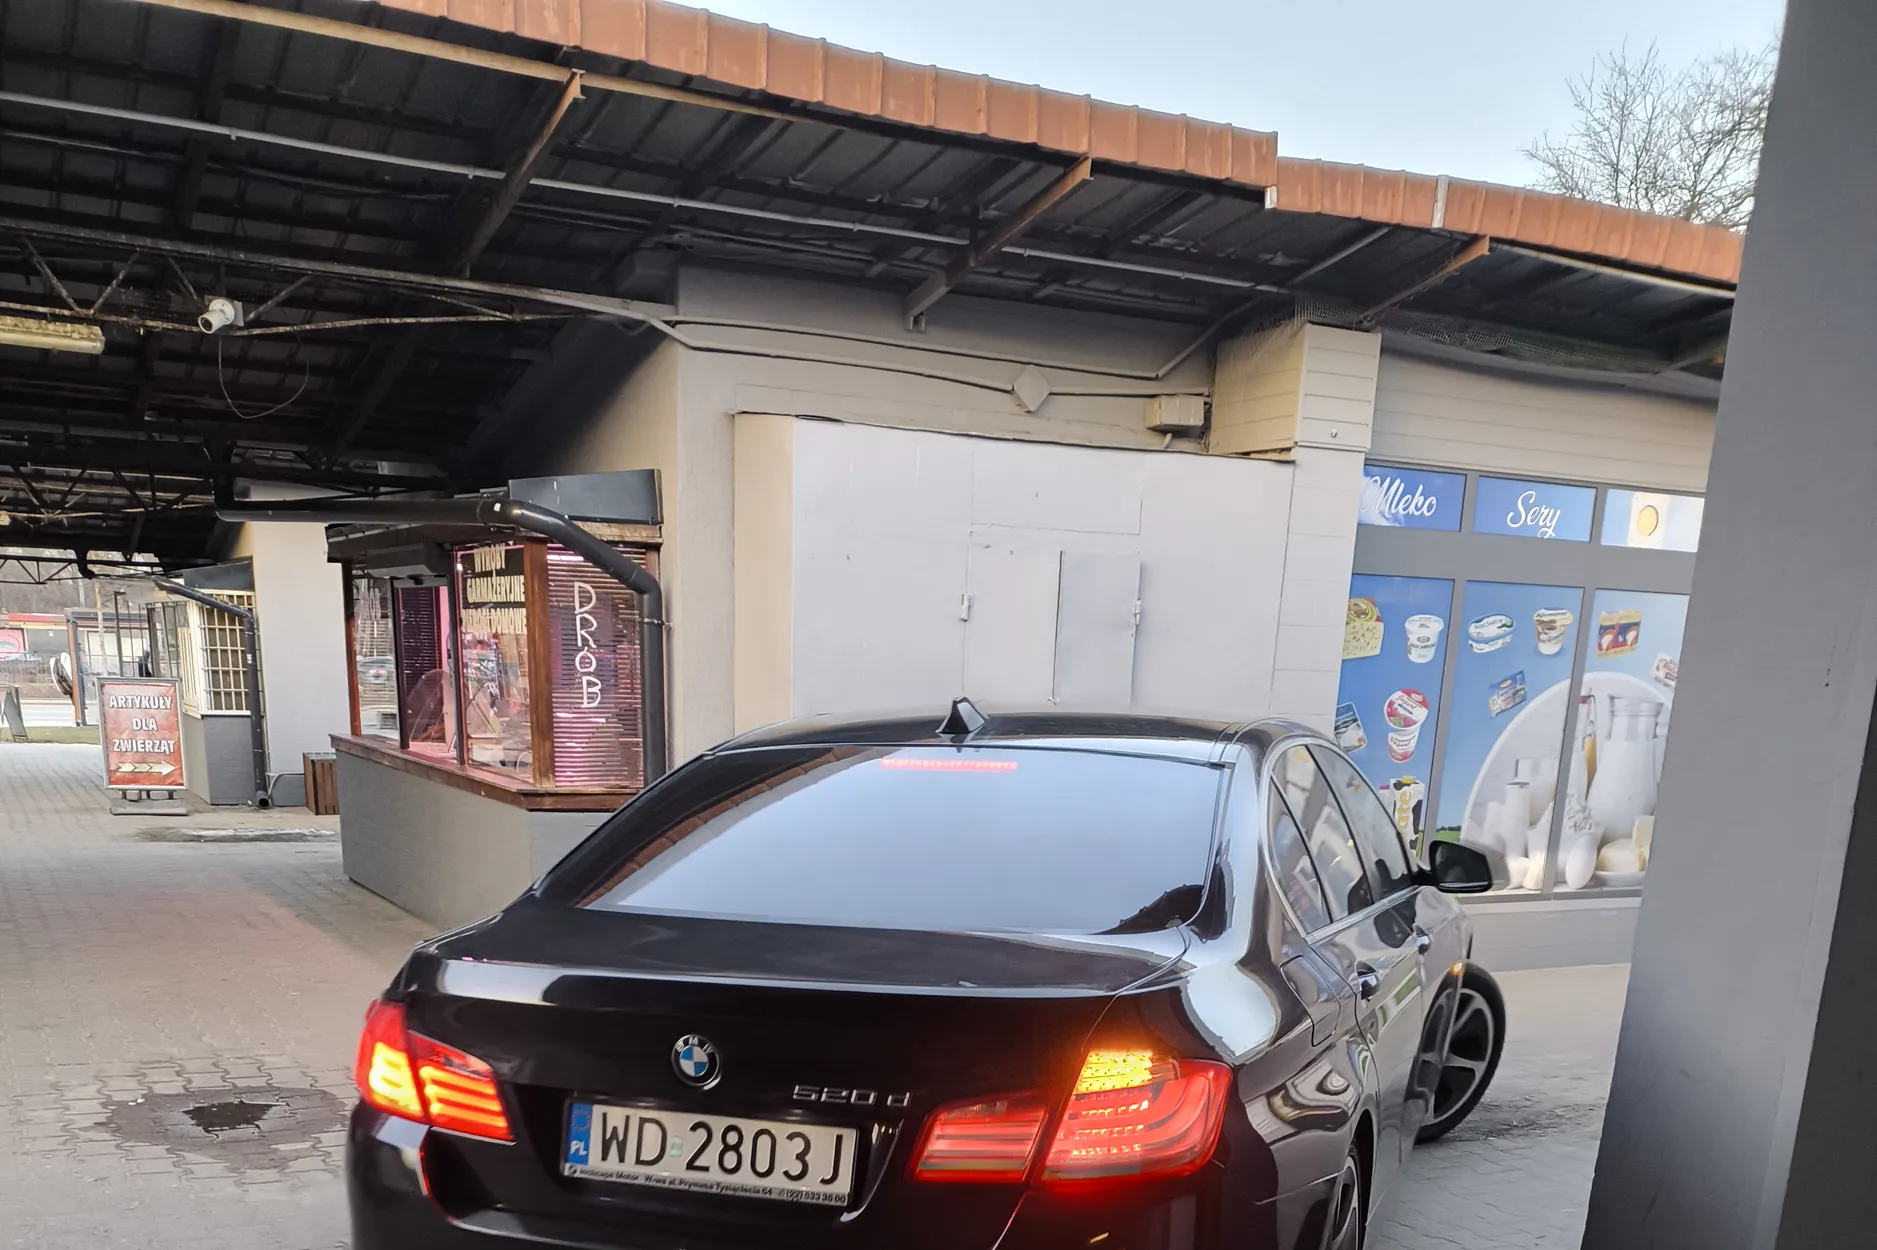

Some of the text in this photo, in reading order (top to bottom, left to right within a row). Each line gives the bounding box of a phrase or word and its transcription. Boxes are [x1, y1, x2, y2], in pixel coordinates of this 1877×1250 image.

[1359, 476, 1437, 518] Mleko
[1506, 490, 1561, 538] Sery
[474, 543, 506, 572] WYROBY
[491, 608, 527, 634] DOMOWE
[109, 694, 172, 710] ARTYKUŁY
[132, 716, 158, 731] DLA
[113, 738, 176, 755] ZWIERZĄT
[675, 1035, 714, 1053] BMW
[570, 1140, 588, 1156] PL
[601, 1112, 845, 1185] WD 2803J
